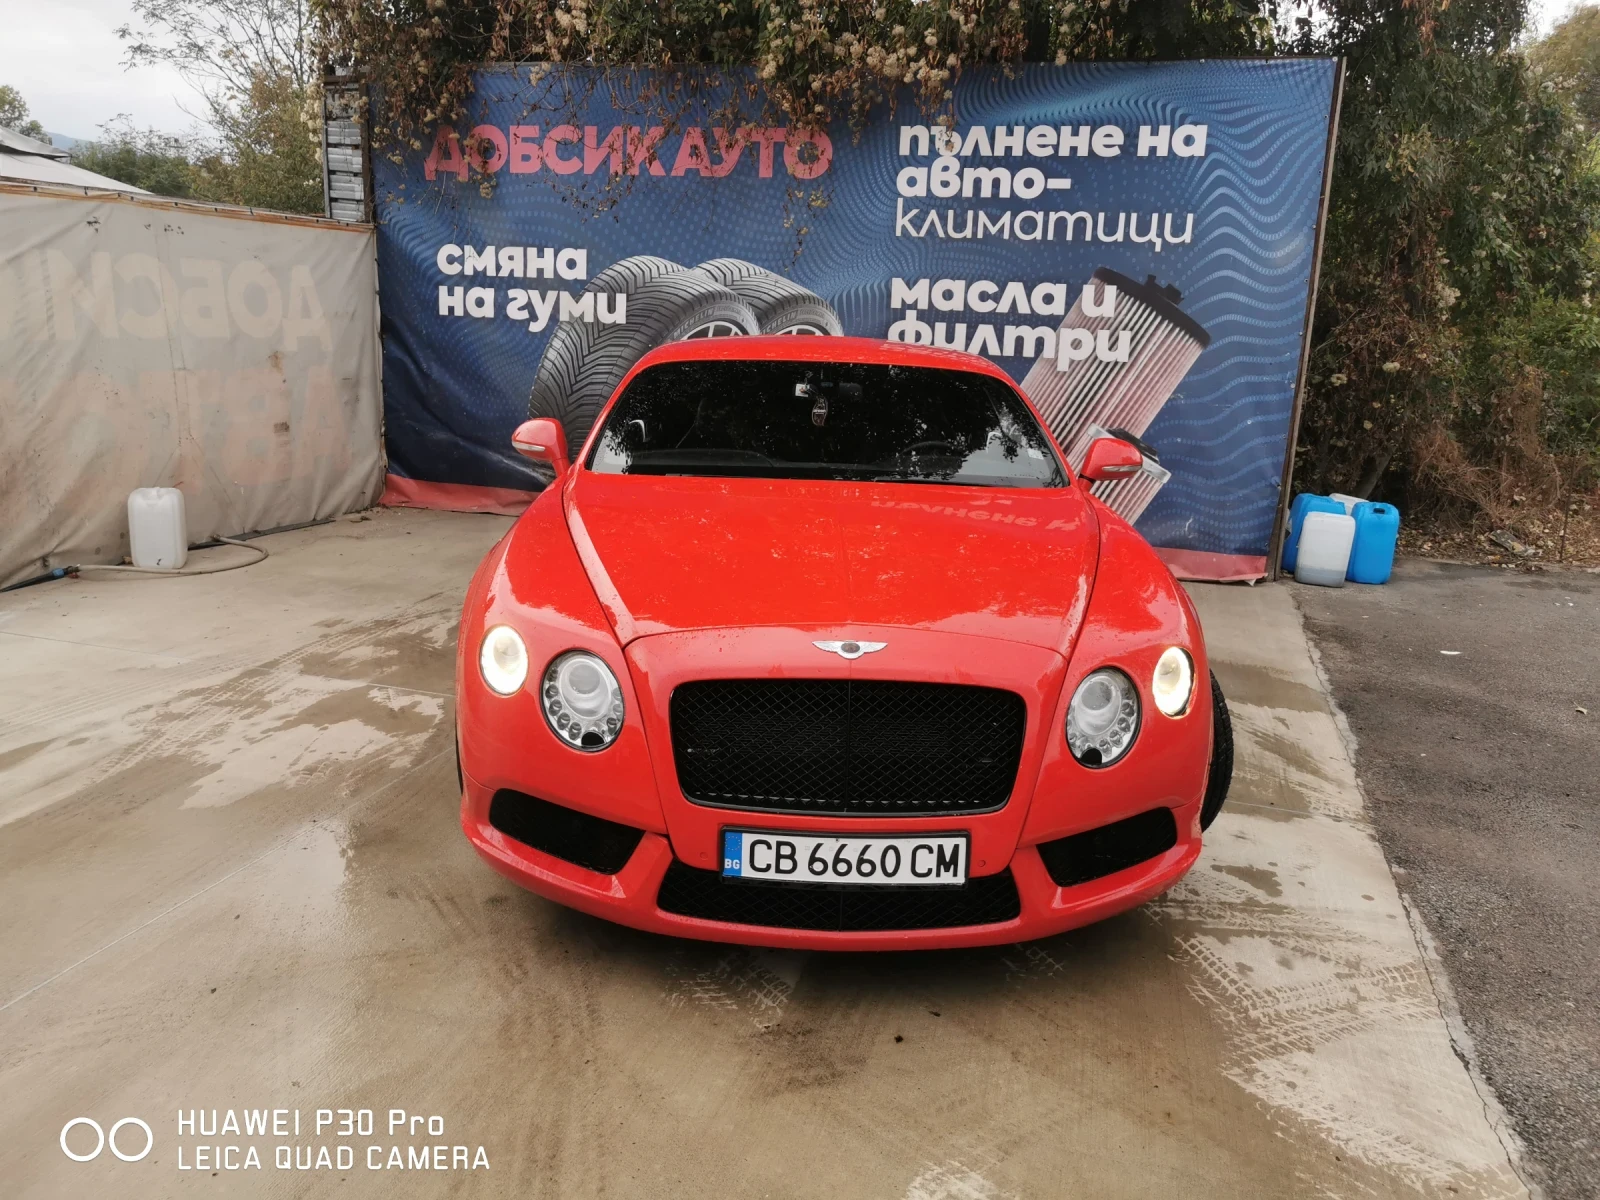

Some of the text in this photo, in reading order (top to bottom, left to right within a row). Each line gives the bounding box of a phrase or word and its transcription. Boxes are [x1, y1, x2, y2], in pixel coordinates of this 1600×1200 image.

[899, 124, 1208, 157] пълнене на
[896, 157, 1072, 199] авто-
[895, 198, 1194, 252] климатици
[436, 243, 587, 281] смяна
[438, 285, 627, 333] на гуми
[890, 277, 1118, 318] масла и
[887, 309, 1133, 372] филтри
[724, 858, 741, 869] BG
[749, 839, 960, 878] CB 6660 CM
